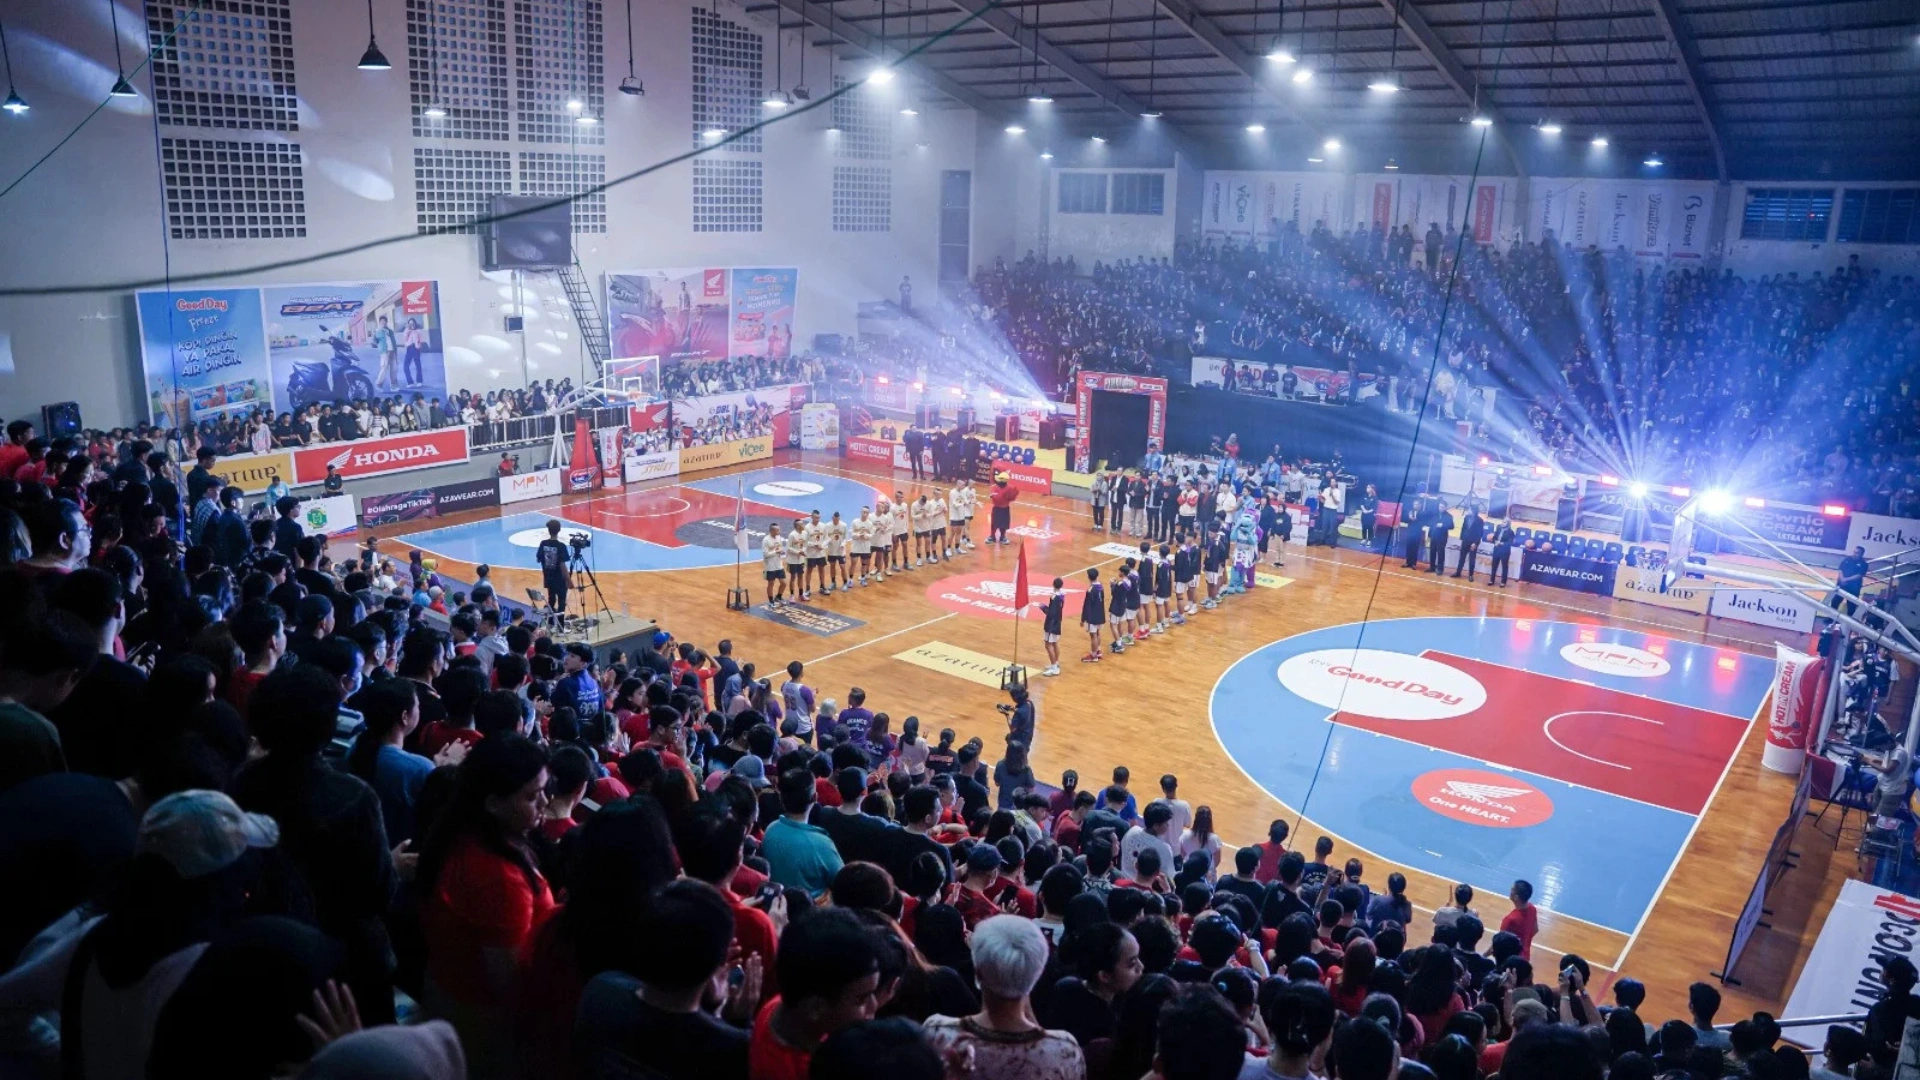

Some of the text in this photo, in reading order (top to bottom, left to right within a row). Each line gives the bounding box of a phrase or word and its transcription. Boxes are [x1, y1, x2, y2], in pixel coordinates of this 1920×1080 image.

[1612, 192, 1628, 243] Jackson
[1682, 214, 1697, 247] Biznet
[178, 331, 238, 352] KOPI DINGIN
[184, 343, 235, 363] YA PAKAI
[182, 354, 241, 377] AIR DINGIN
[354, 444, 440, 467] HONDA
[512, 473, 550, 491] MPM
[1011, 472, 1047, 485] HONDA
[439, 487, 494, 504] AZAWEAR.COM
[366, 497, 433, 515] #OlahragaTikTok
[1762, 522, 1824, 537] CREAM
[1530, 563, 1603, 583] AZAWEAR.COM
[940, 592, 971, 603] One
[1728, 593, 1797, 619] Jackson
[1574, 646, 1660, 669] MPM
[1774, 706, 1786, 724] HOT
[1781, 660, 1798, 696] CREAM
[1428, 796, 1458, 809] One
[1440, 787, 1518, 813] HONDA
